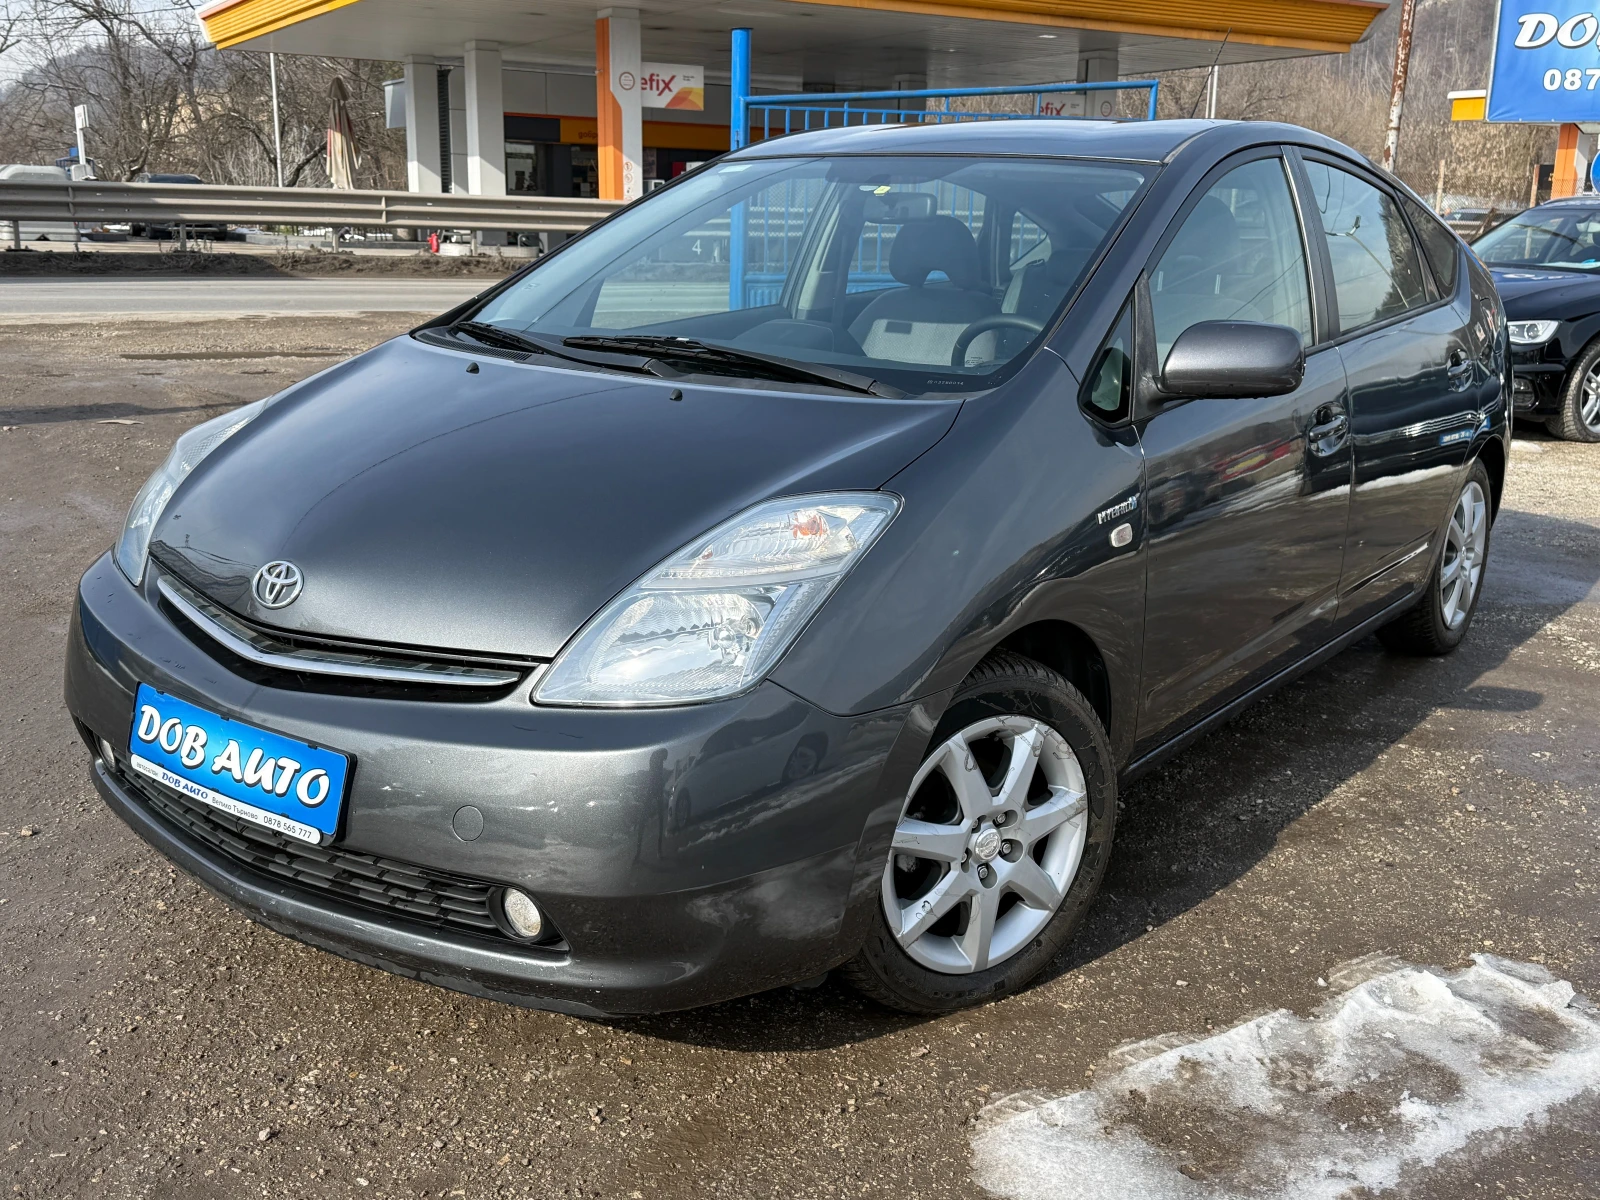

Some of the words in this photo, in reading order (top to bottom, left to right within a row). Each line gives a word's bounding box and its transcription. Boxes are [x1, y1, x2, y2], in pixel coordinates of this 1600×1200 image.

[1514, 12, 1600, 51] DO
[1543, 68, 1600, 91] 087
[692, 239, 702, 255] 4
[137, 704, 208, 769] DOB
[211, 739, 330, 807] AUTO
[162, 772, 181, 788] DOB
[182, 783, 208, 800] AUTO
[263, 815, 282, 829] 0878
[283, 821, 296, 834] 565
[298, 827, 312, 839] 777
